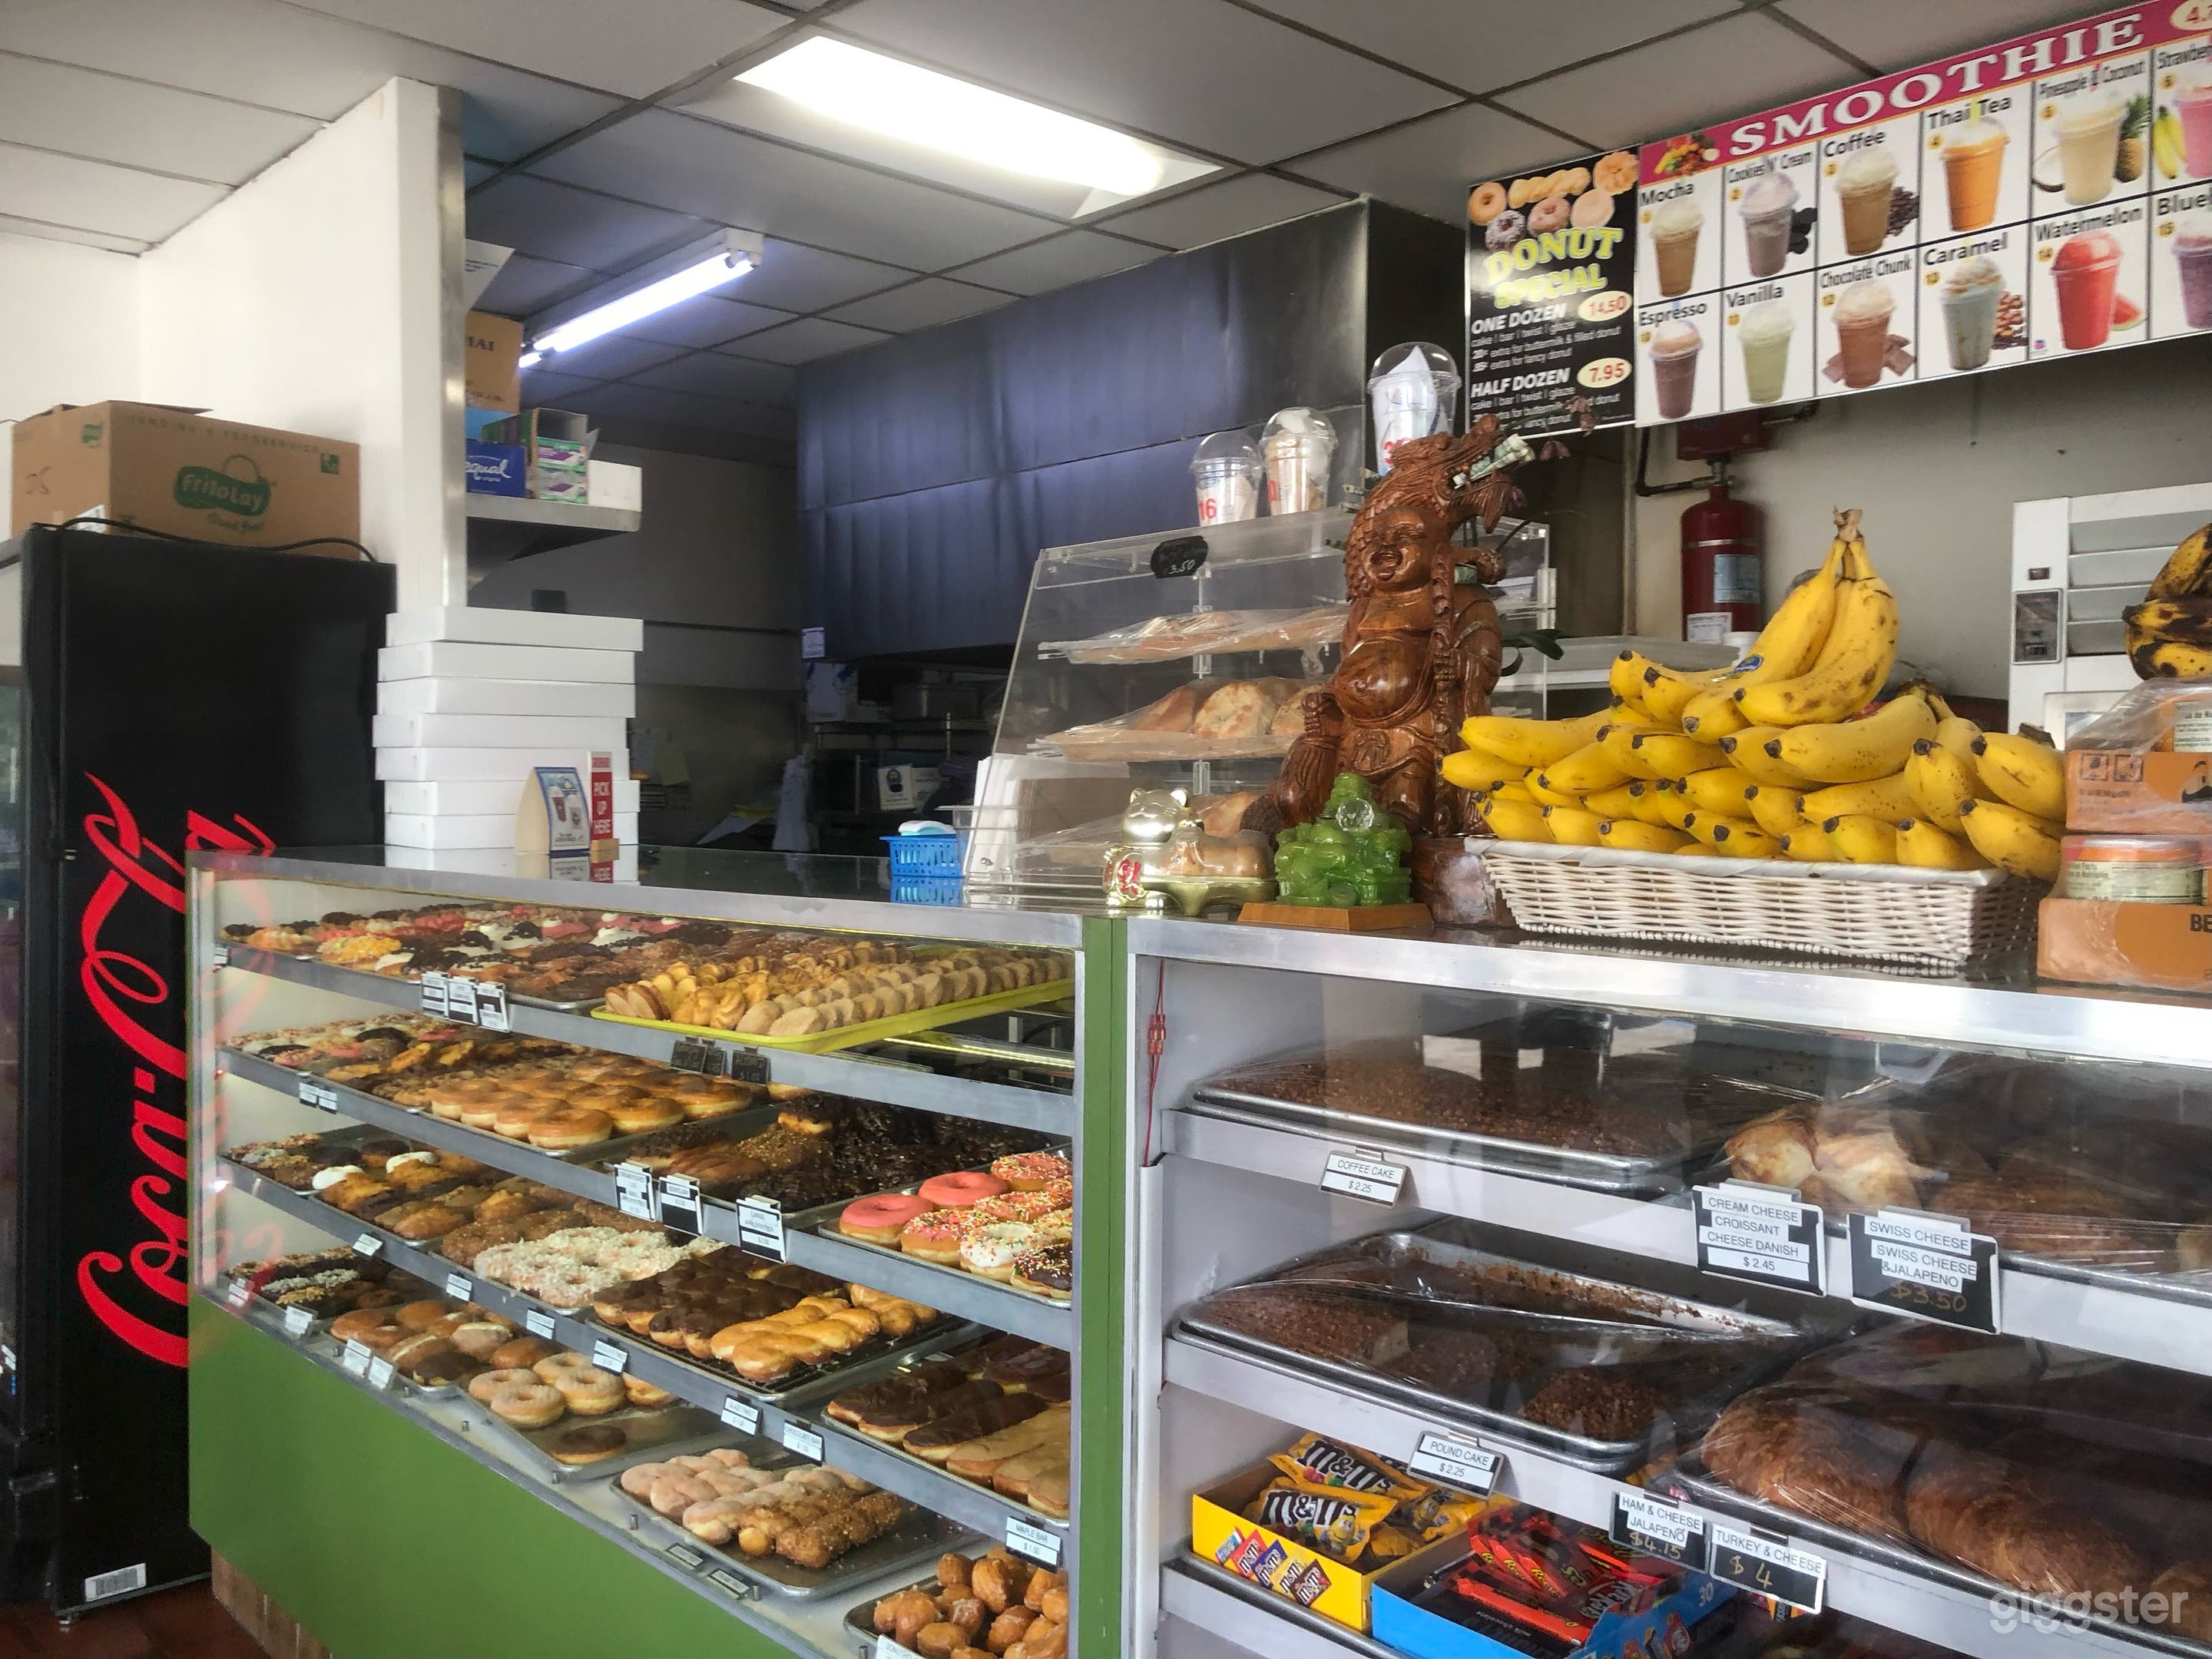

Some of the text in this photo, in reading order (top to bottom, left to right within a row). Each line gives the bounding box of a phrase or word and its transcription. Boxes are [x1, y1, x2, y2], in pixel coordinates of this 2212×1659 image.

[1729, 13, 2144, 155] SMOOTHIE
[1929, 95, 2011, 130] Thai Tea
[1824, 130, 1886, 157] Coffee
[1639, 182, 1694, 207] Mocha
[2035, 206, 2143, 241] Watermelon
[1482, 227, 1624, 286] DONUT
[1924, 232, 2008, 266] Caramel
[1820, 254, 1913, 289] Chocolate Chunk
[1494, 263, 1608, 309] SPECIAL
[1727, 283, 1784, 308] Vanilla
[1472, 303, 1568, 334] ONE DOZEN
[1588, 295, 1627, 316] 14.50
[1639, 301, 1708, 328] Espresso
[1471, 367, 1571, 398] HALF DOZEN
[1588, 362, 1624, 382] 7.95
[1198, 498, 1217, 520] 16
[1168, 559, 1195, 575] 3.50
[1337, 1160, 1395, 1179] COFFEE CAKE
[1708, 1197, 1799, 1224] CREAM CHEESE
[1714, 1215, 1780, 1237] CROISSANT
[1869, 1220, 1969, 1251] SWISS CHEESE
[1707, 1231, 1799, 1257] CHEESE DANISH
[1876, 1243, 1977, 1277] SWISS CHEESE
[1882, 1262, 1959, 1288] &JALAPENO
[1430, 1441, 1490, 1466] POUND CAKE
[1622, 1496, 1701, 1531] HAM & CHEESE
[1015, 1524, 1048, 1543] MAPLE BAR
[1628, 1531, 1684, 1561] $4.15
[1716, 1529, 1822, 1573] TURKEY & CHEESE
[1731, 1555, 1773, 1589] $ 4
